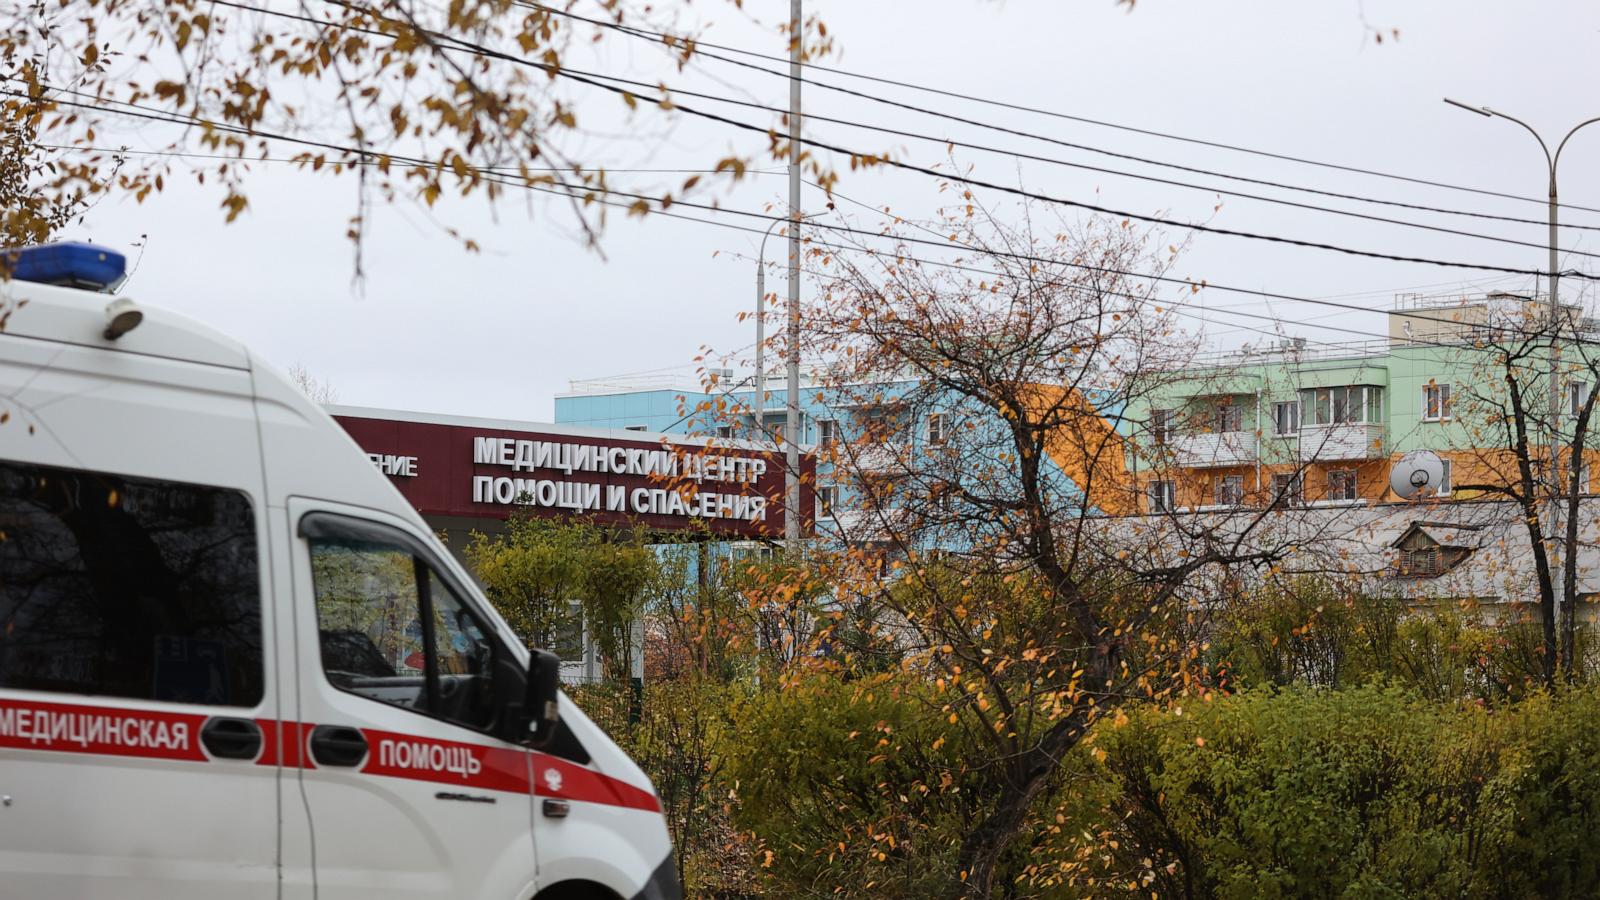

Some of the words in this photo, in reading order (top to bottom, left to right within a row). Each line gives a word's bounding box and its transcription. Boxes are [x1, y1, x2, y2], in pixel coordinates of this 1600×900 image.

[473, 436, 677, 477] МЕДИЦИНСКИЙ
[682, 452, 767, 484] ЦЕНТР
[473, 475, 600, 514] ПОМОЩИ
[606, 484, 625, 512] И
[630, 487, 766, 521] СПАСЕНИЯ
[0, 707, 189, 750] МЕДИЦИНСКАЯ
[379, 739, 482, 779] ПОМОЩЬ
